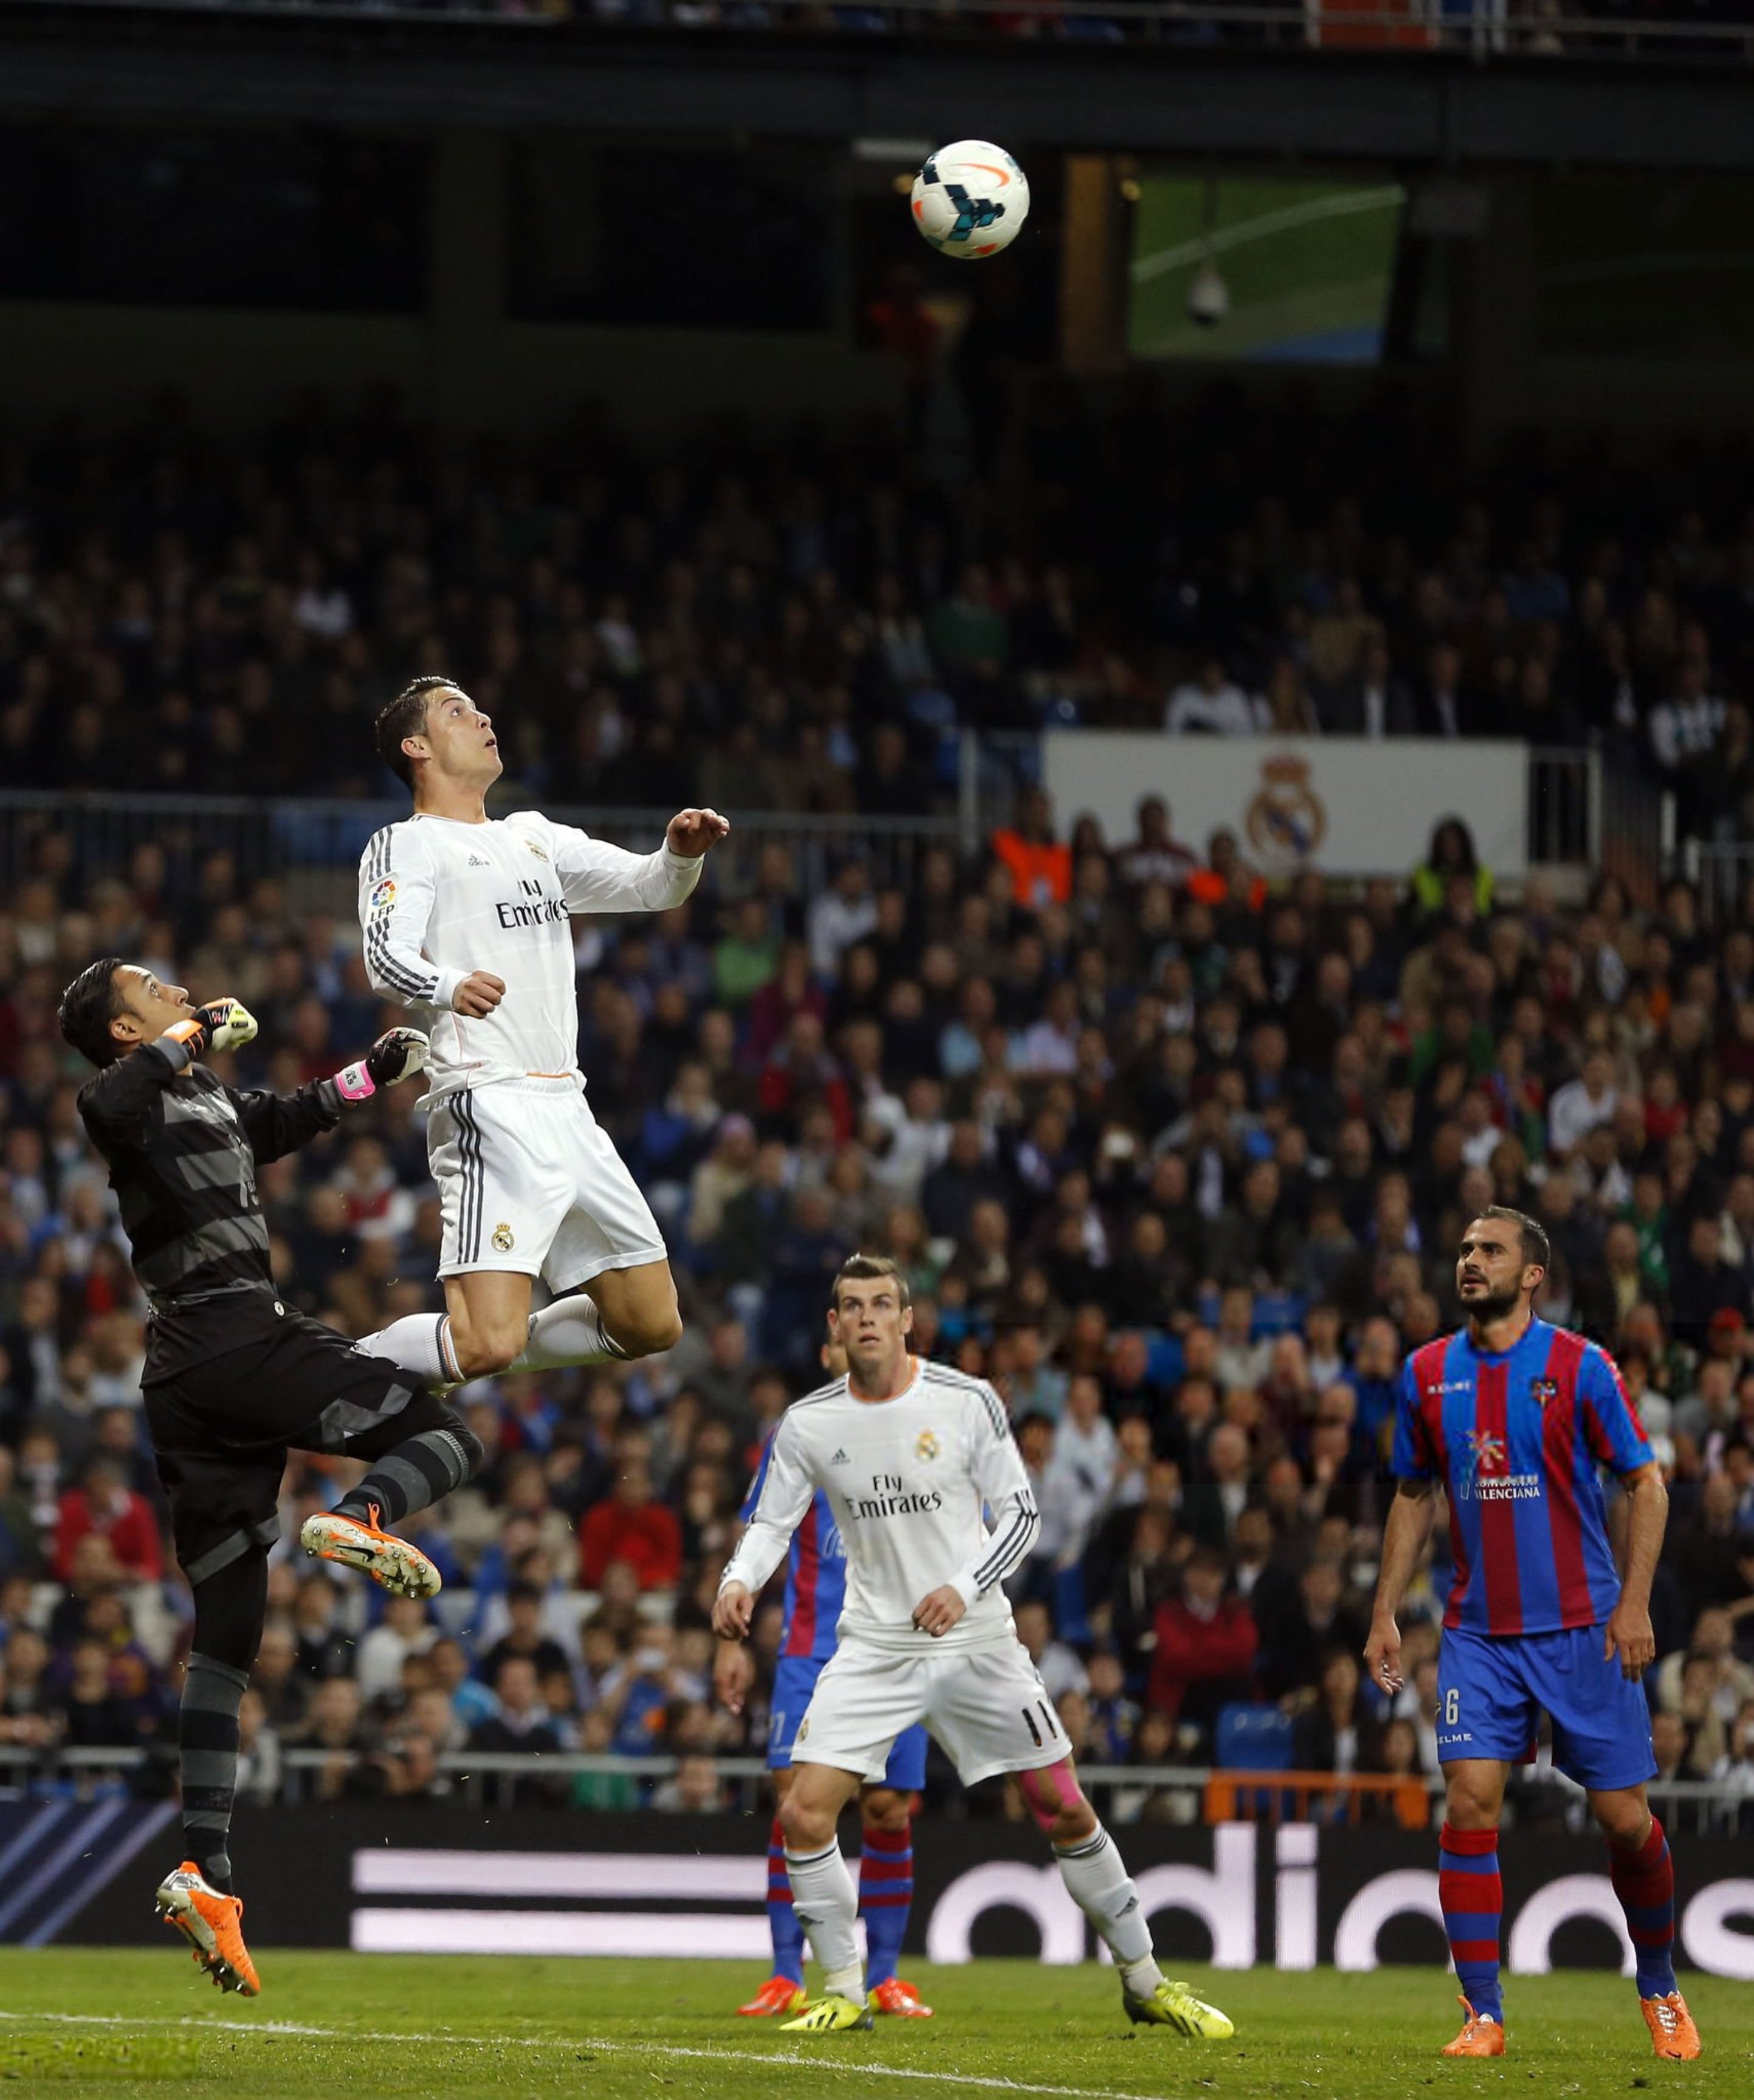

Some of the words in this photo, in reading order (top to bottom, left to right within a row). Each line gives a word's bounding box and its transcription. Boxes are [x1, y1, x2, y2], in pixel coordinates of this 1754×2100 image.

[370, 904, 395, 922] LFP
[872, 1474, 902, 1492] Fly
[844, 1491, 943, 1520] Emirates
[1446, 1688, 1459, 1725] 6
[1022, 1699, 1058, 1747] 11
[1439, 1733, 1472, 1744] ELME
